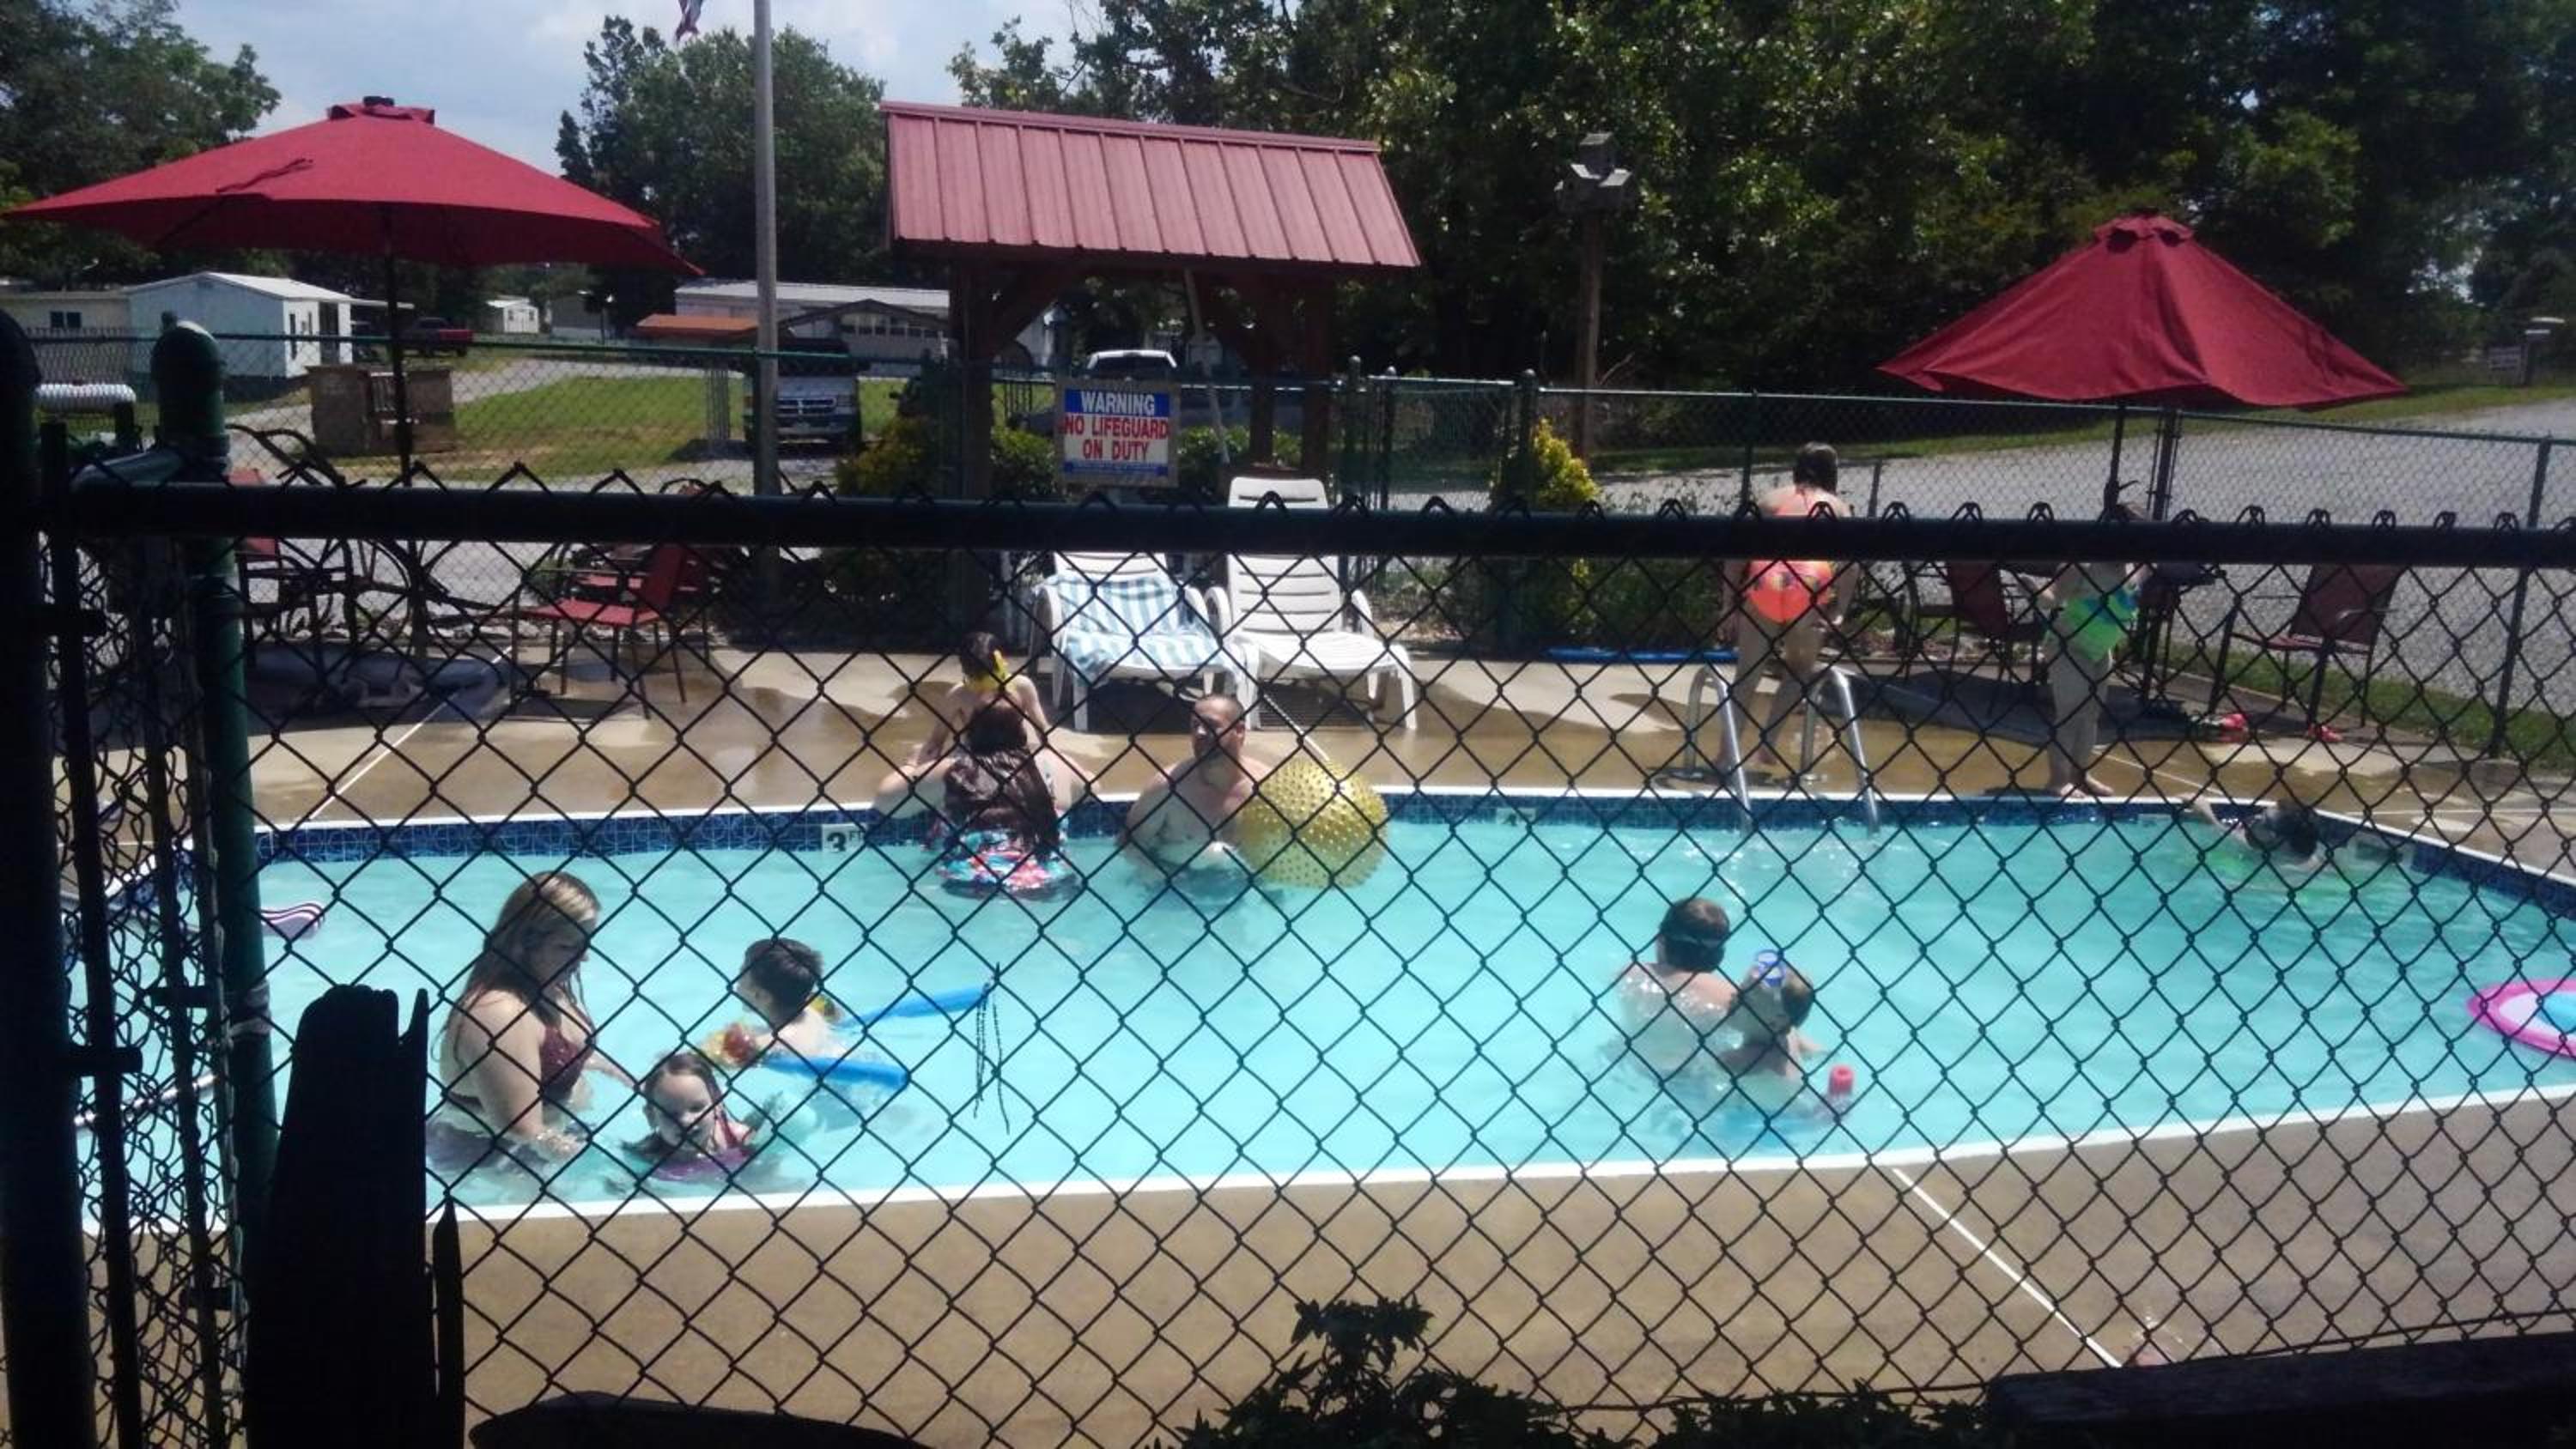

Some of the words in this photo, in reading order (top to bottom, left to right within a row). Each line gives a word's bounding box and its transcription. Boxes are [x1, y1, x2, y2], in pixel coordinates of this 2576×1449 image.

[1081, 391, 1155, 415] WARNING
[1064, 415, 1084, 434] NO
[1091, 417, 1169, 440] LIFEGUARD
[1083, 439, 1103, 458] ON
[1112, 441, 1149, 460] DUTY
